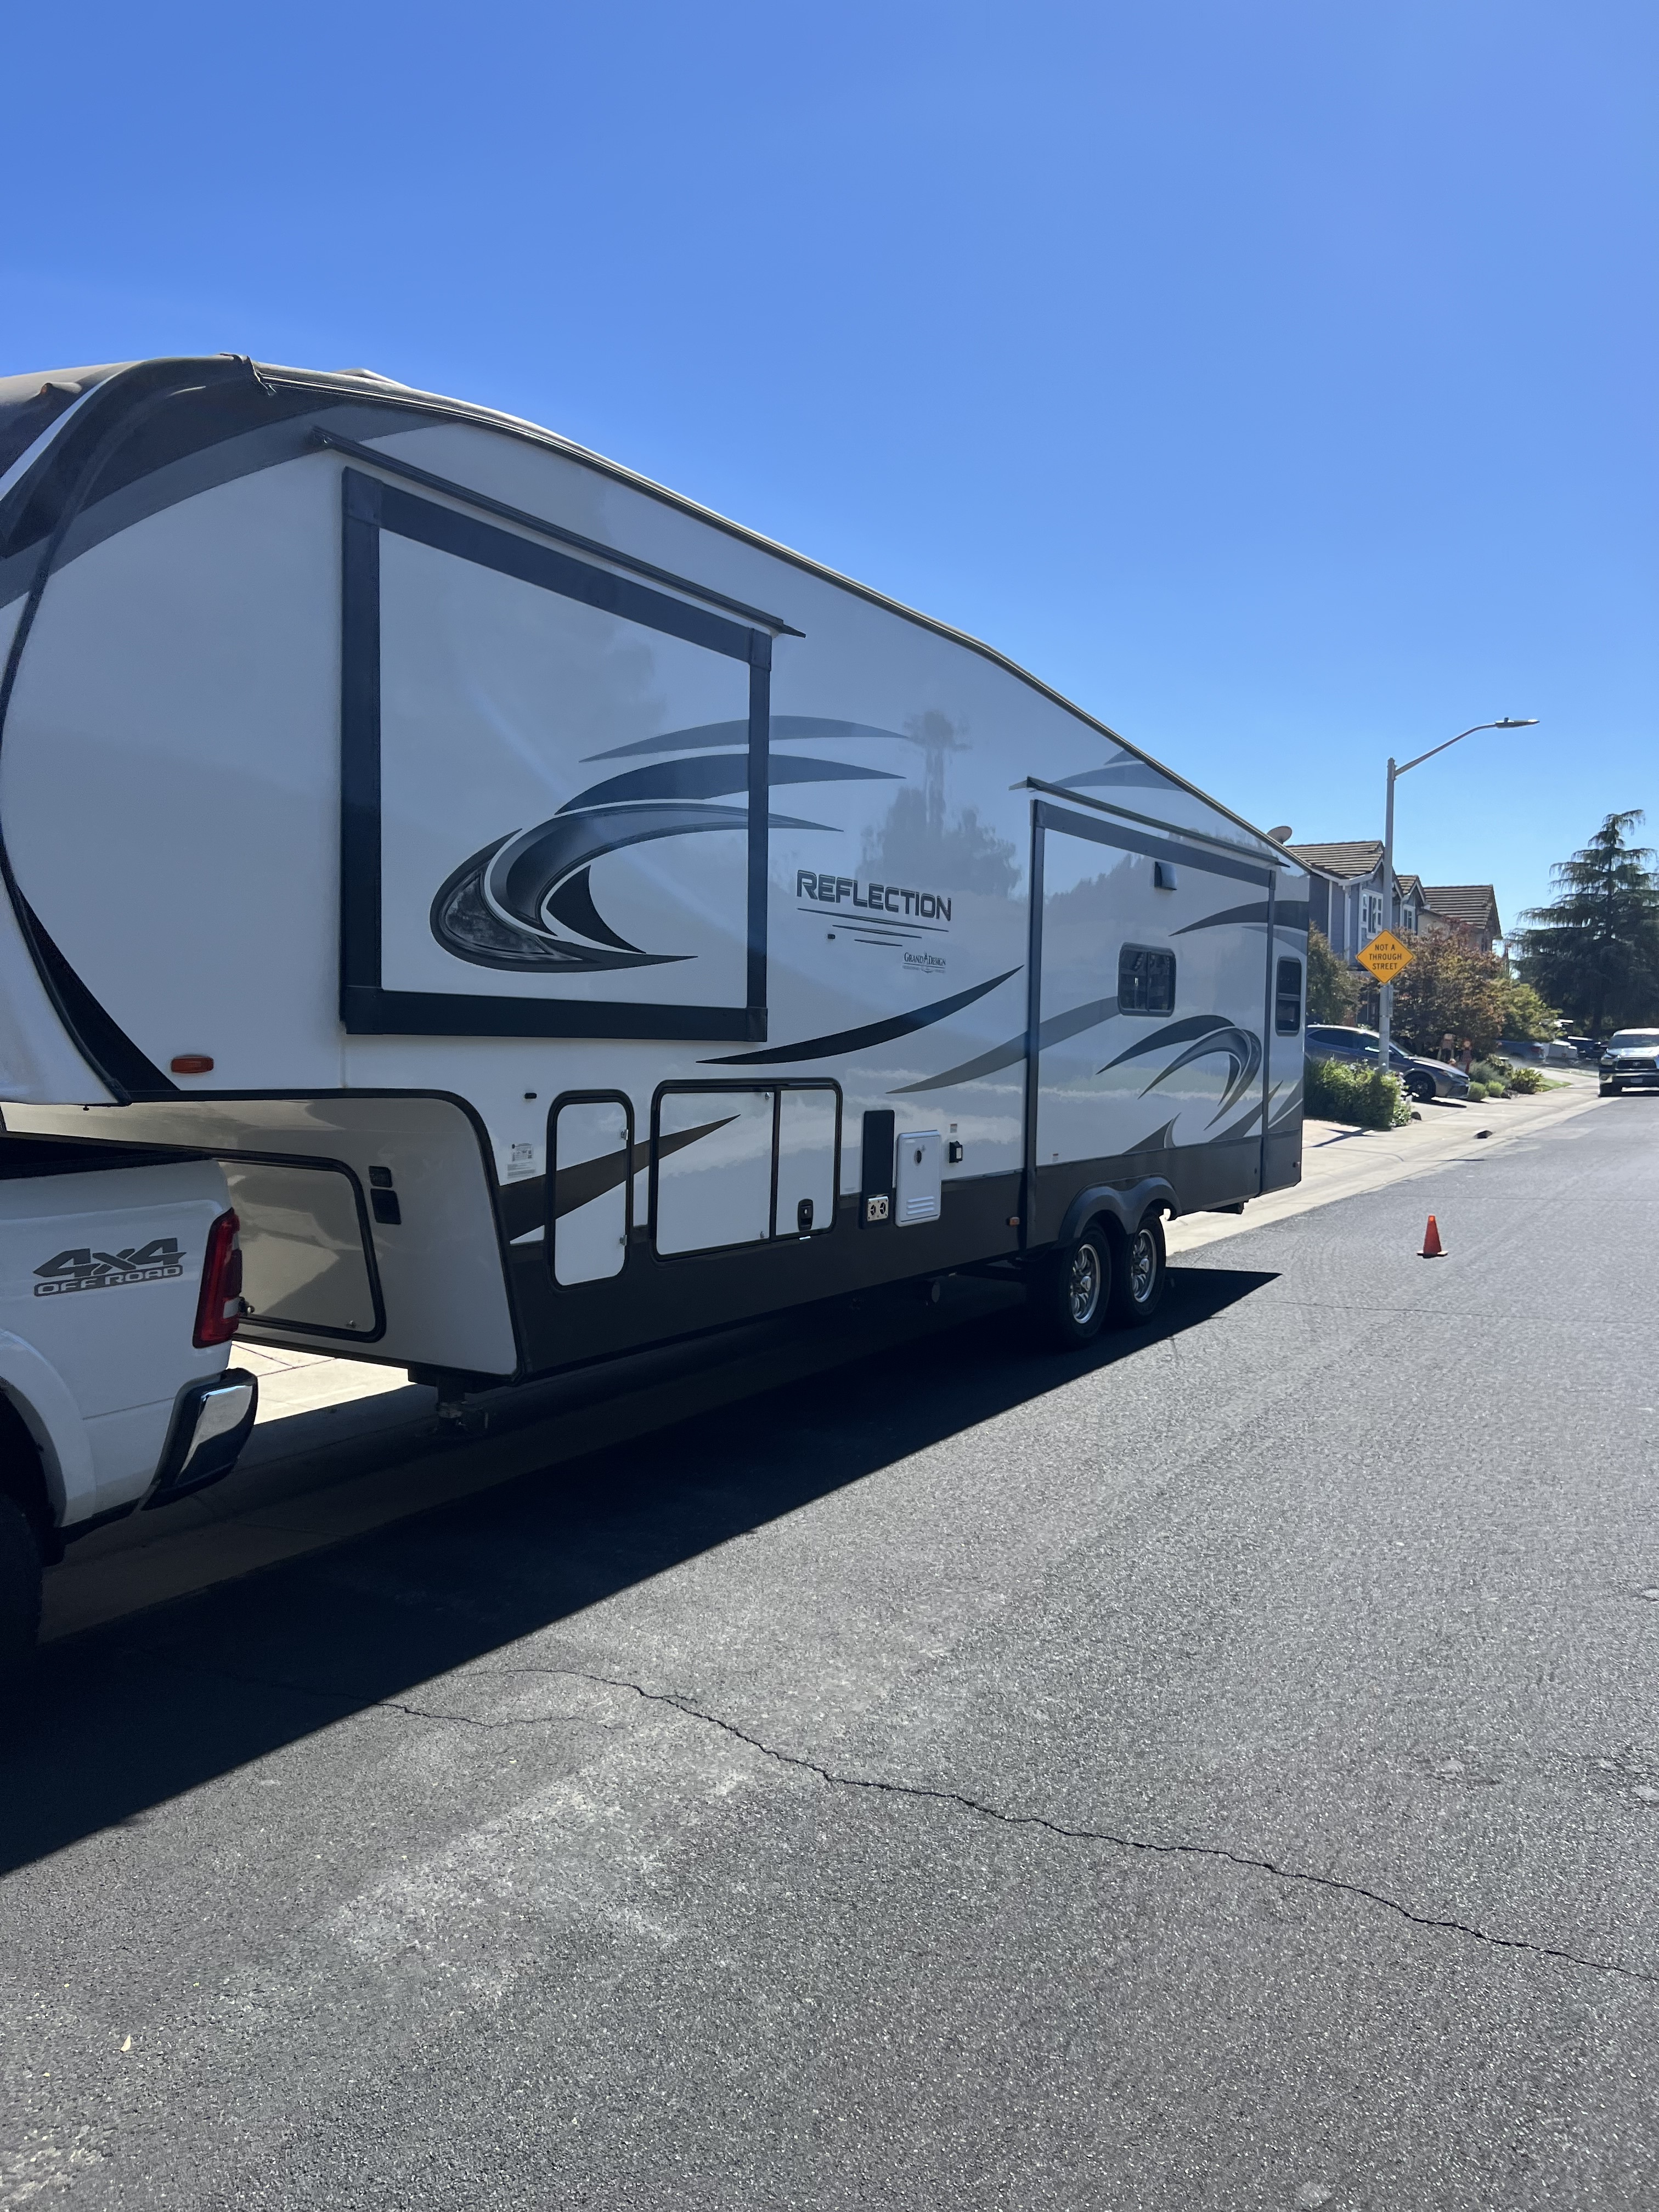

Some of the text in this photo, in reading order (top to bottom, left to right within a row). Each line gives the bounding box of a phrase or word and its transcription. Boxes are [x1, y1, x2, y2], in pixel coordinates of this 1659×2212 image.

[796, 869, 952, 922] REFLECTION
[904, 952, 924, 964] GRAND
[37, 1266, 181, 1295] OFF ROAD
